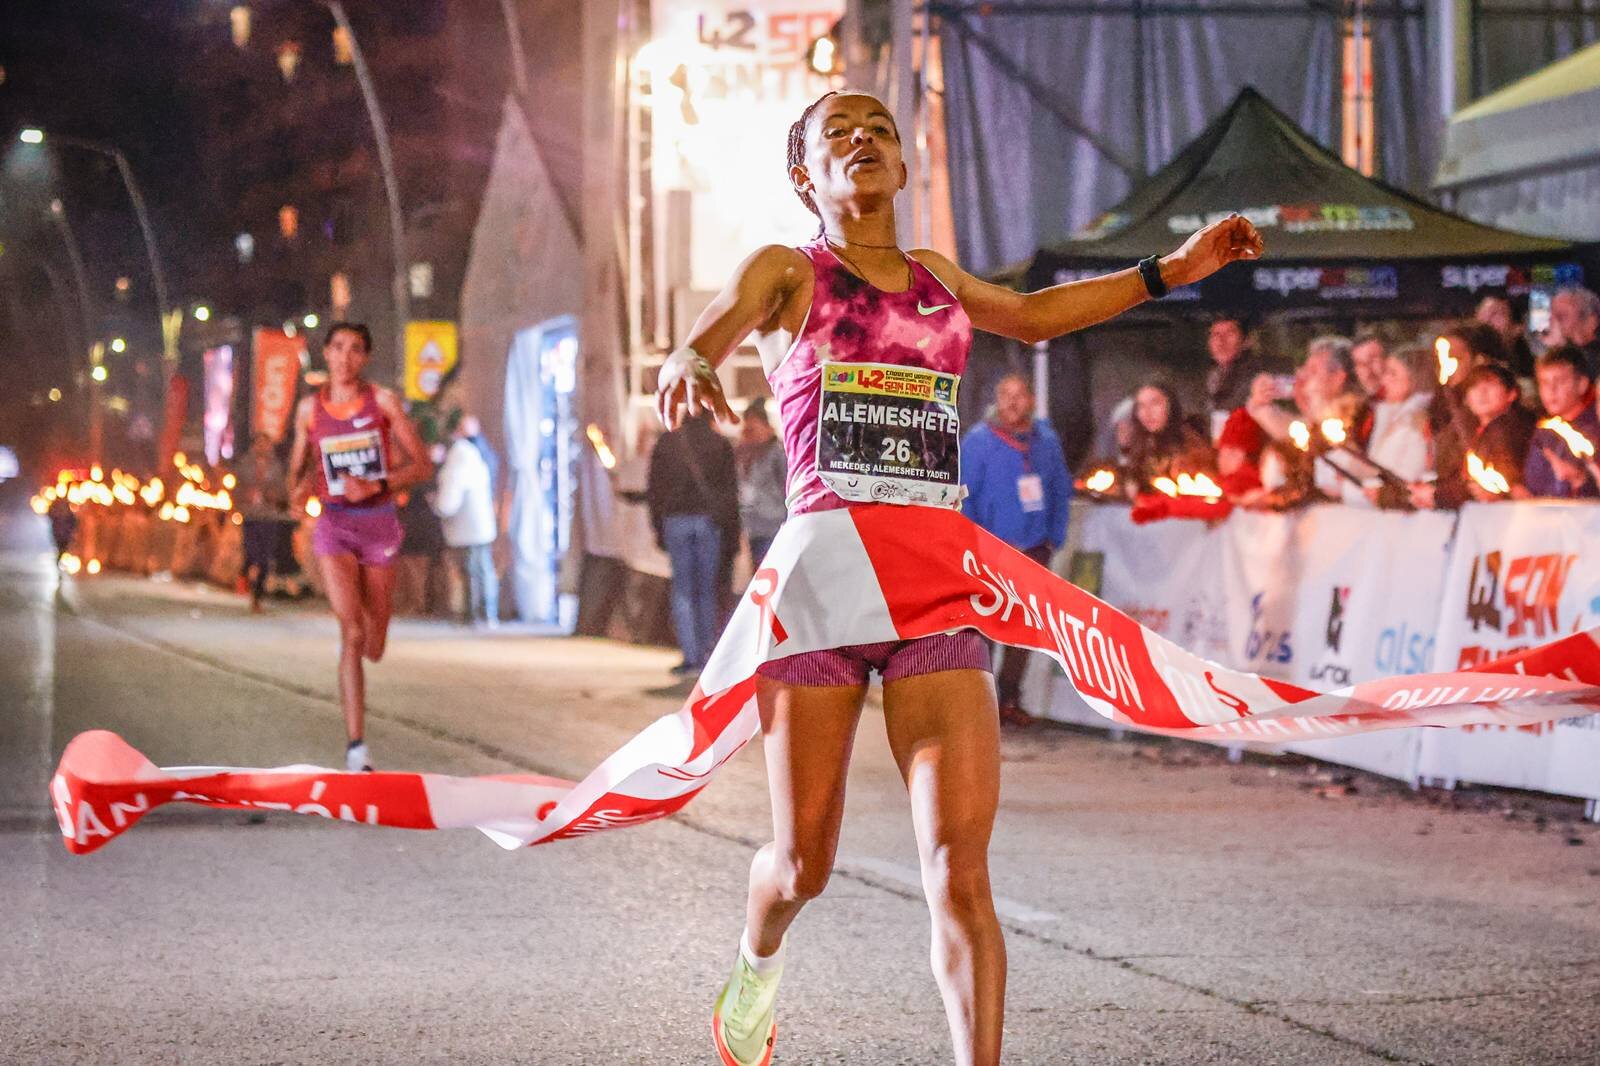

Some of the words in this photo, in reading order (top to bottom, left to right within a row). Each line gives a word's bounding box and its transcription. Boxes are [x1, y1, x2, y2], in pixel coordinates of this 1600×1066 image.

[699, 11, 756, 50] 42
[857, 369, 885, 390] 42
[823, 402, 958, 434] ALEMESHETE
[880, 437, 910, 463] 26
[830, 460, 870, 472] MEKEDES
[873, 464, 925, 477] ALEMESHETE
[926, 469, 950, 480] YADETI
